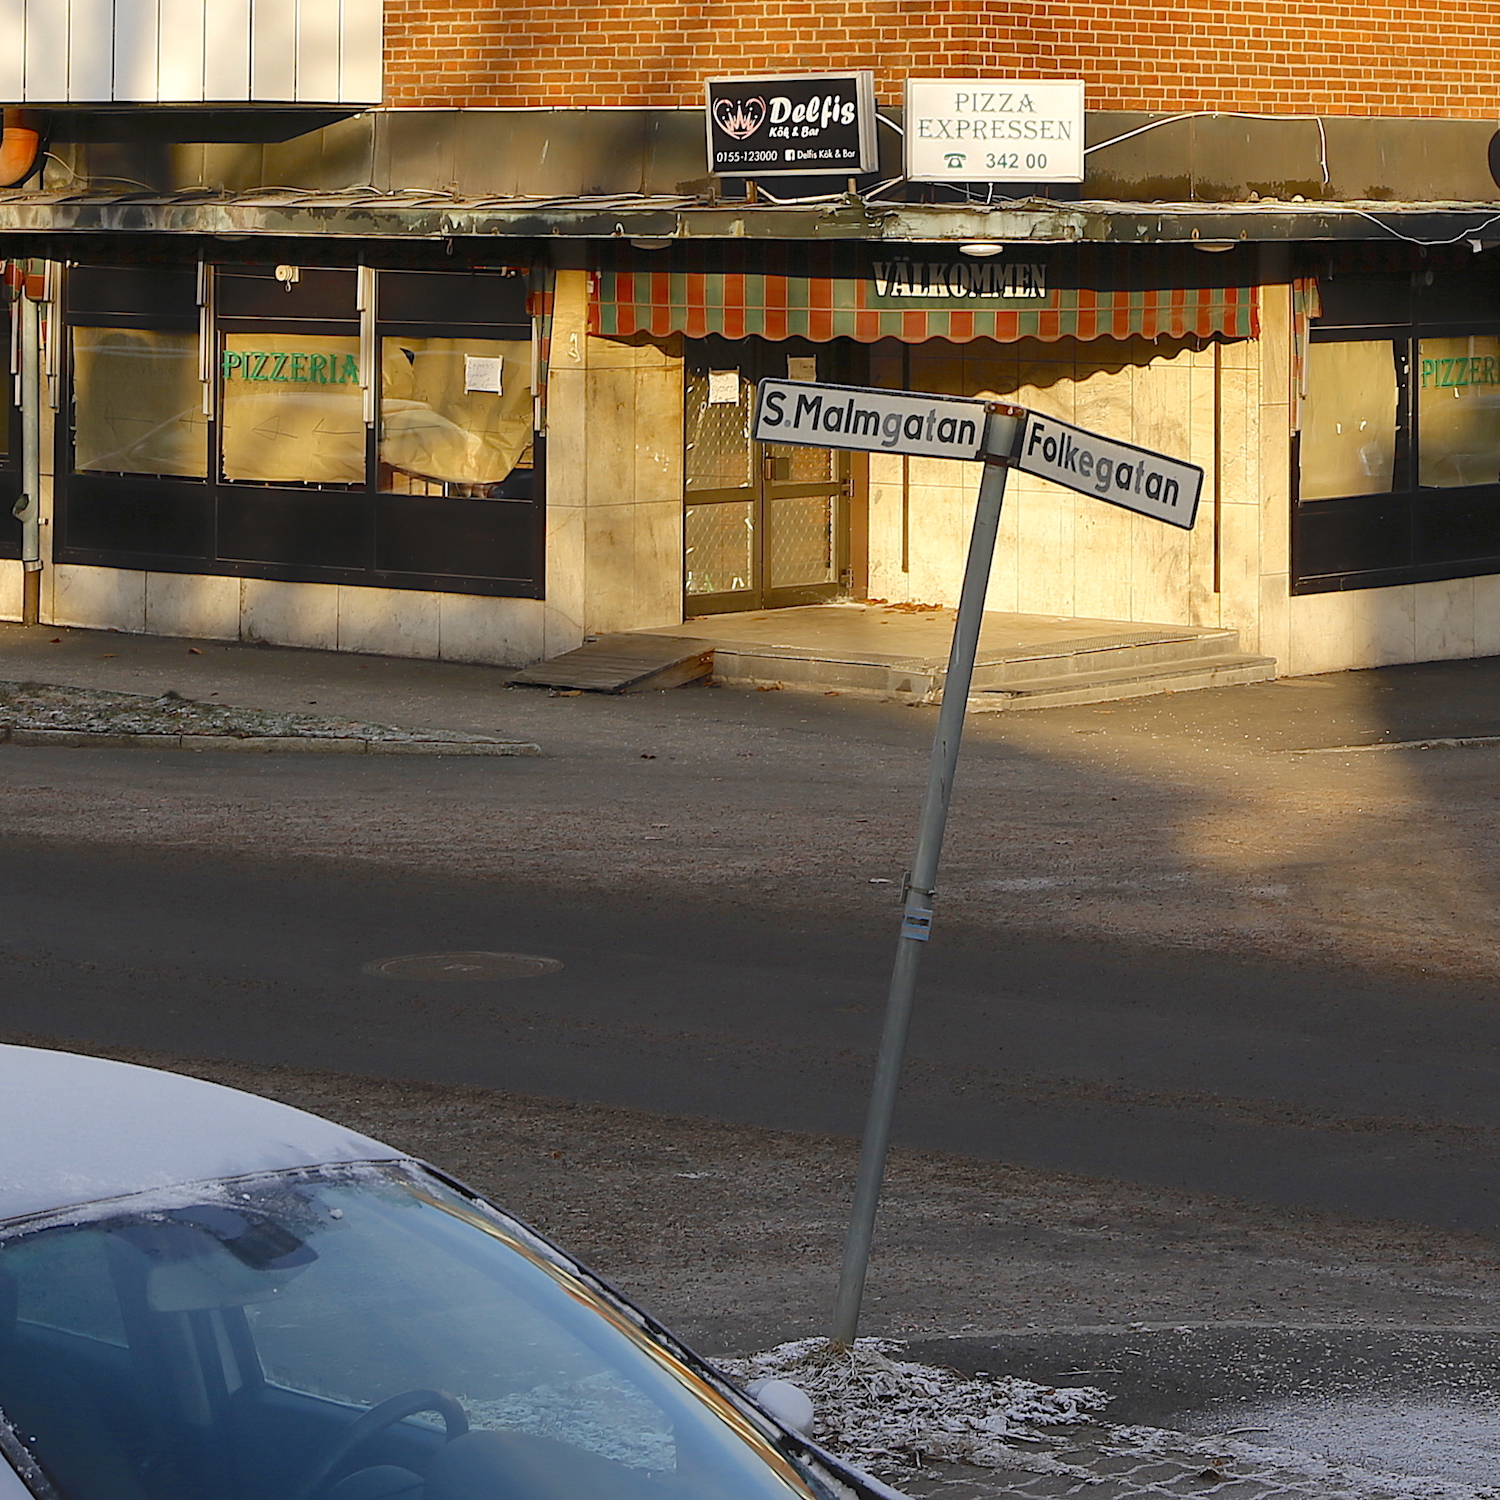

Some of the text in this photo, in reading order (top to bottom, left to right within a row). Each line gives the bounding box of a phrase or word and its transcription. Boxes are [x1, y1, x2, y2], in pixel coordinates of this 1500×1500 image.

[769, 95, 855, 129] Delfis
[954, 93, 1037, 113] PIZZA
[792, 127, 799, 137] &
[801, 126, 819, 138] Bar
[917, 119, 1073, 140] EXPRESSEN
[716, 151, 778, 163] 0155-123000
[986, 153, 1047, 169] 342 00
[872, 256, 1047, 298] VÄLKOMMEN
[222, 351, 360, 384] PIZZERIA
[1027, 422, 1179, 507] Folkegatan
